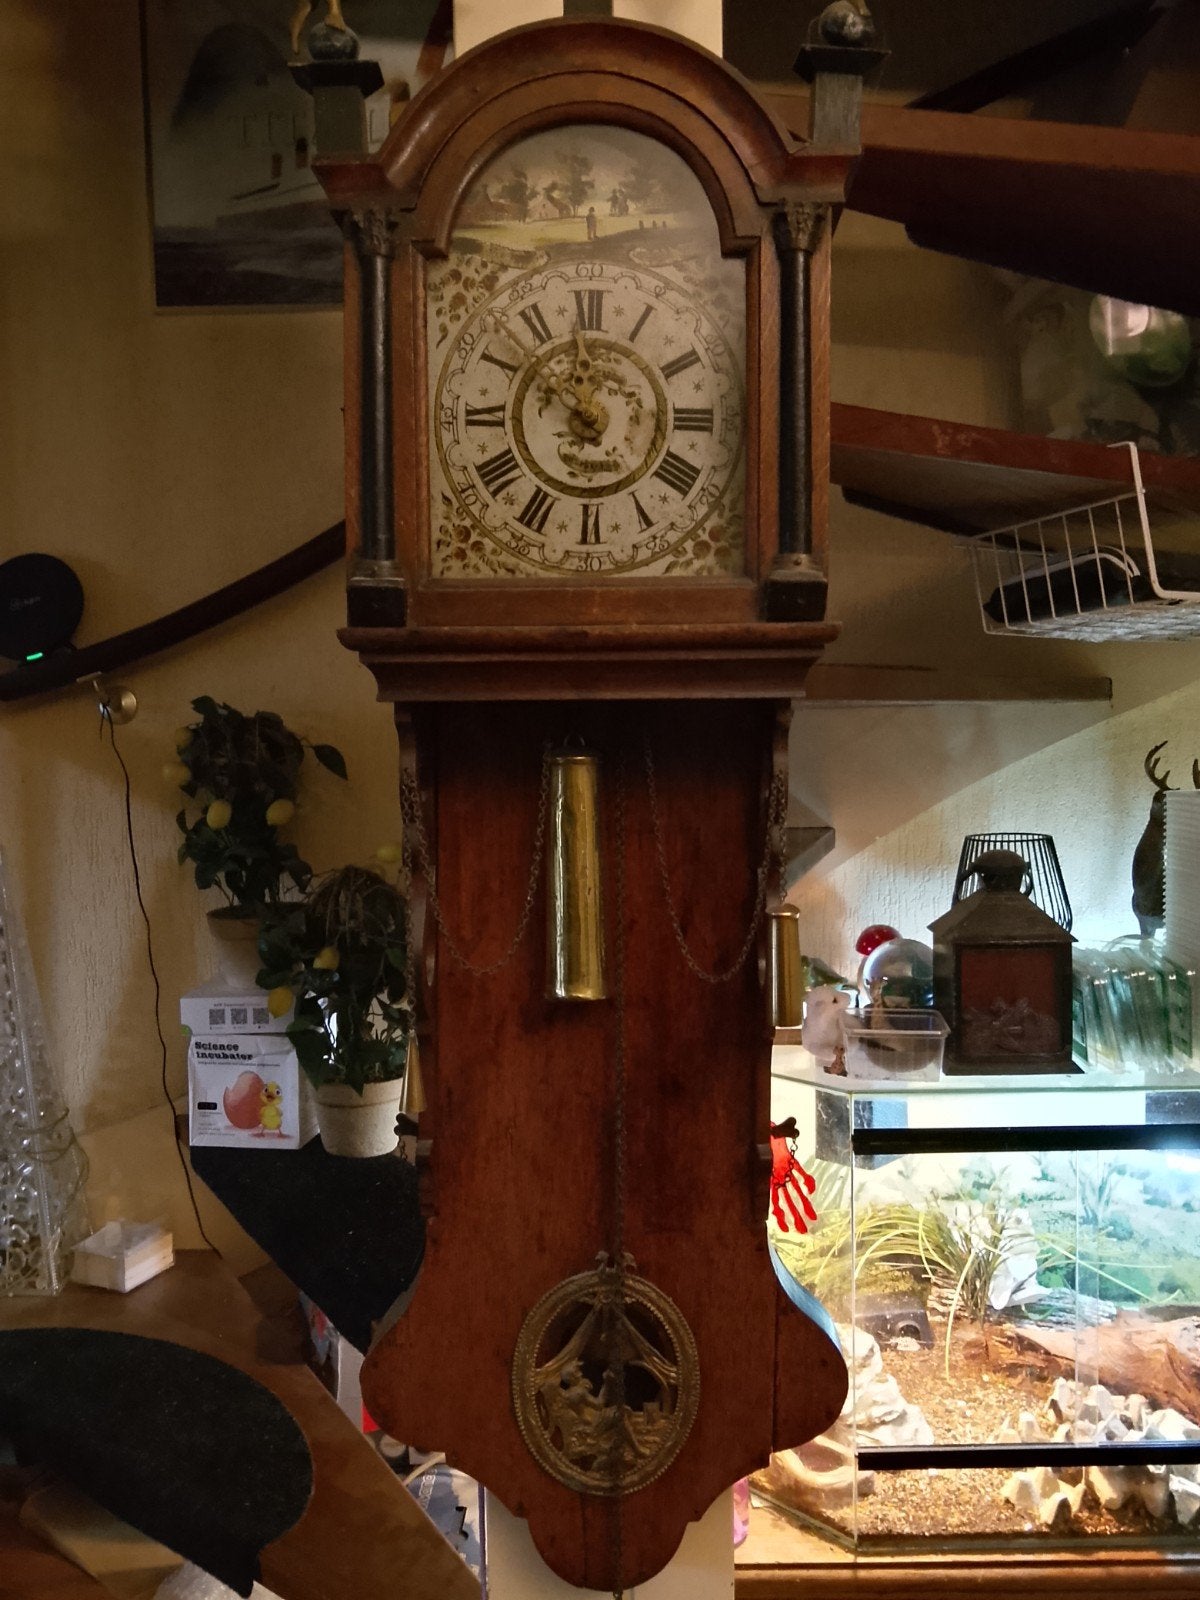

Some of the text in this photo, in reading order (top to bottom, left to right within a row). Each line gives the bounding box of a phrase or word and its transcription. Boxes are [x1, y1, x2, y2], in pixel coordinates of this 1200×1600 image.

[575, 263, 603, 277] 60
[515, 300, 560, 351] XI
[567, 289, 612, 333] XII
[628, 302, 657, 343] I
[476, 343, 523, 390] X
[658, 343, 705, 385] II
[465, 400, 507, 435] IX
[672, 402, 714, 435] III
[472, 442, 526, 501] VIII
[650, 445, 703, 501] IIII
[457, 482, 478, 506] 40
[513, 484, 561, 537] VII
[628, 490, 659, 534] V
[576, 503, 607, 545] VI
[576, 555, 602, 571] 30
[194, 1041, 239, 1052] Science
